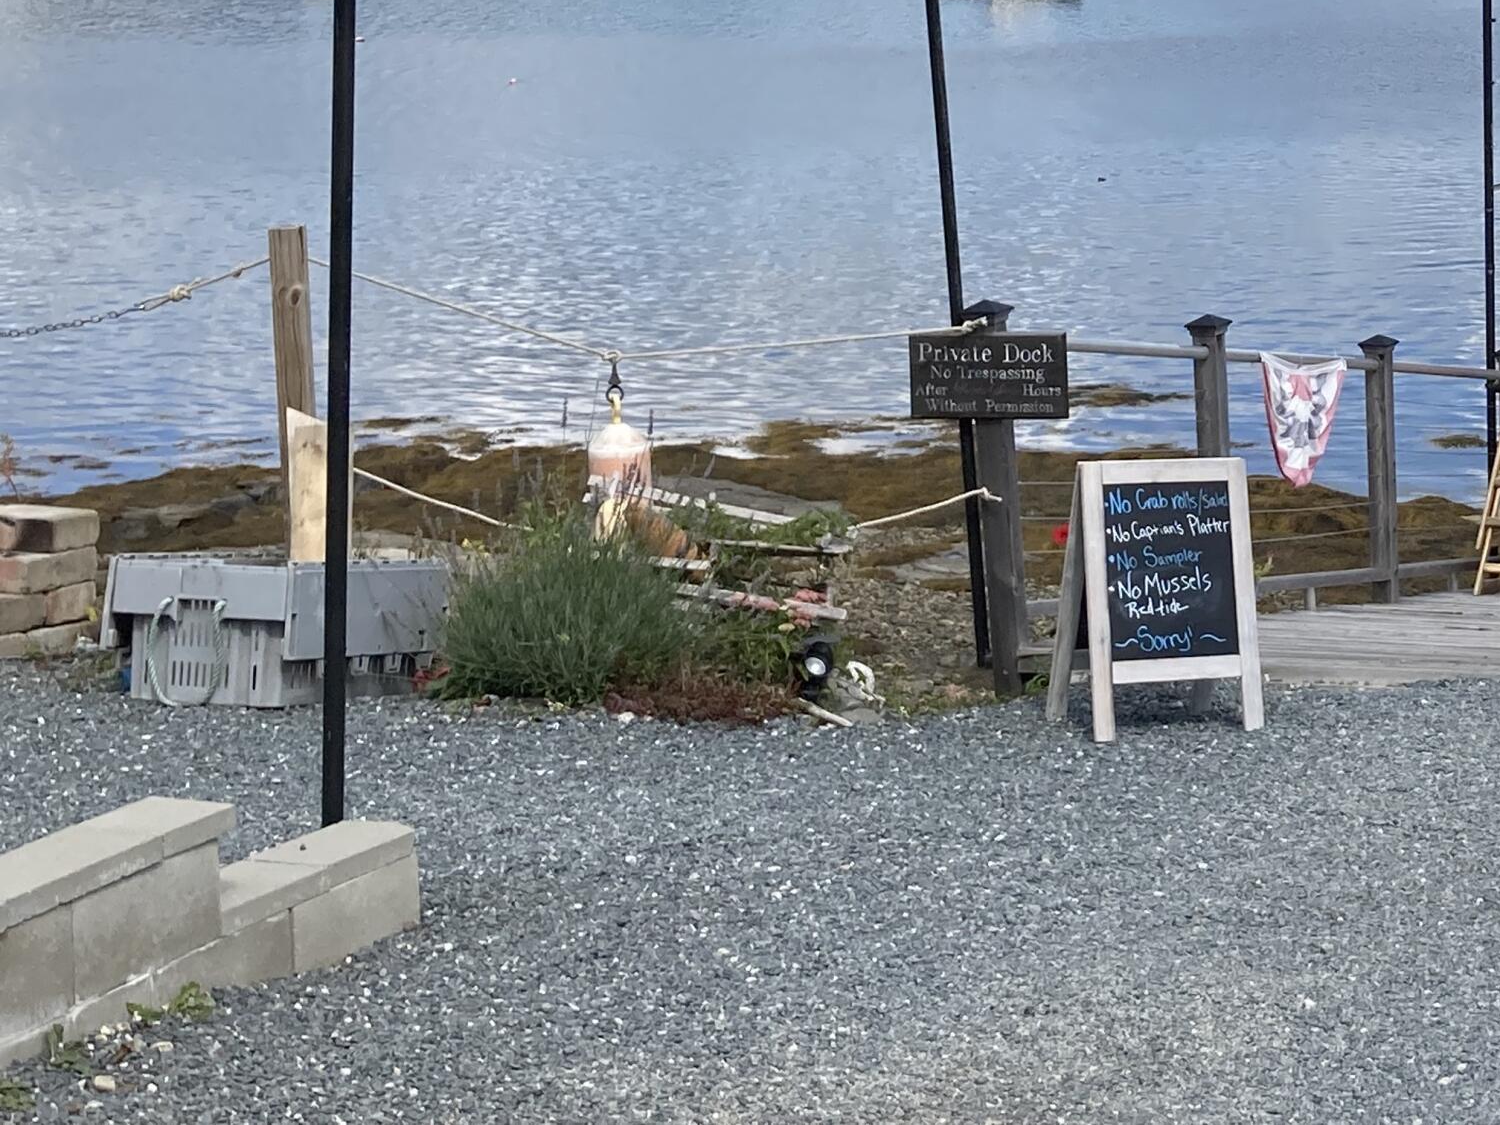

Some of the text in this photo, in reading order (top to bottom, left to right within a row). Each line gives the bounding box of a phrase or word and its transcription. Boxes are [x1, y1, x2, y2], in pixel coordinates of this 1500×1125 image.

[918, 342, 1055, 364] Private Dock
[930, 364, 1046, 384] No Trespassing
[915, 382, 948, 396] After
[1022, 383, 1062, 397] Hours
[924, 397, 1054, 413] Without Permission
[1108, 487, 1133, 516] No
[1135, 487, 1170, 510] Crab
[1111, 523, 1131, 543] No
[1186, 513, 1230, 537] Platter
[1115, 545, 1204, 572] No Sampler
[1117, 565, 1213, 600] No Mussels
